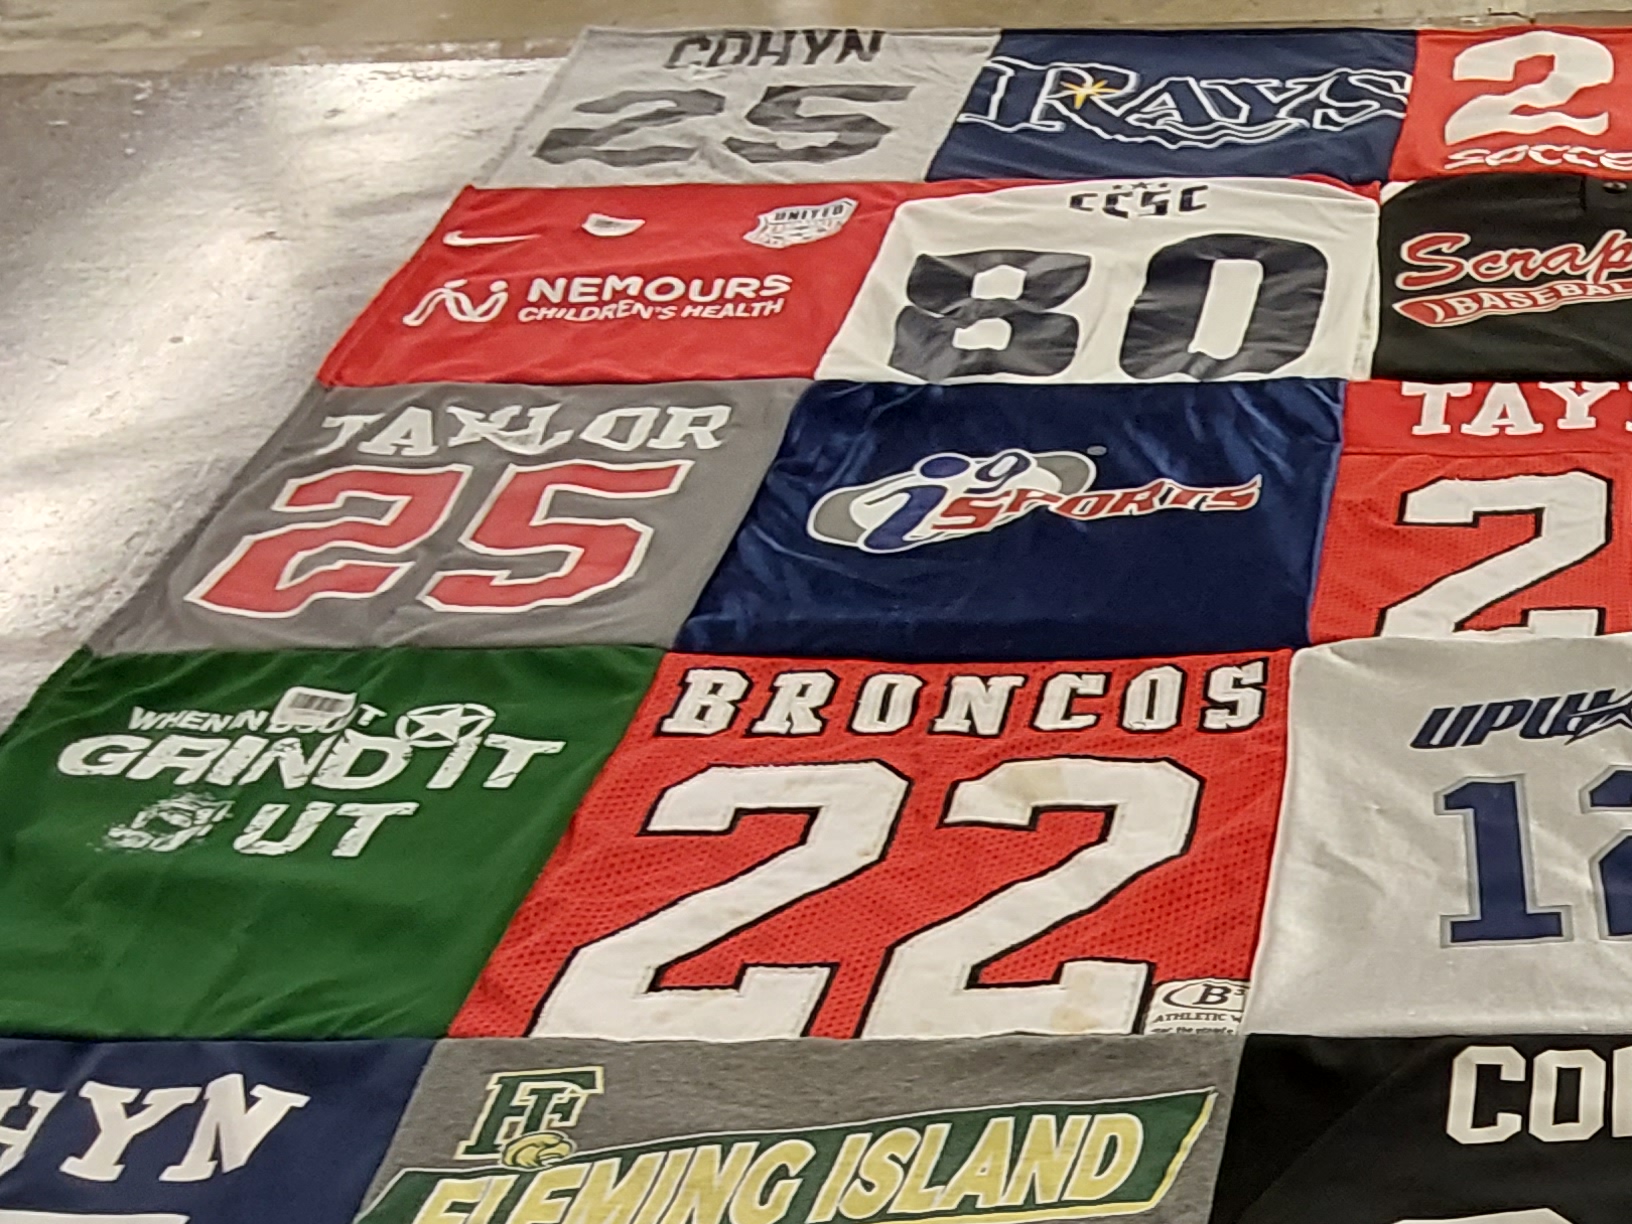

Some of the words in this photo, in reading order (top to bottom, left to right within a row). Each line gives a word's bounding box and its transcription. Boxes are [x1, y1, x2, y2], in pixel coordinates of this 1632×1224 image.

[665, 29, 886, 69] COHYN
[533, 84, 917, 168] 25
[957, 55, 1412, 149] RAYS
[1069, 184, 1208, 219] CCSC
[518, 299, 677, 322] CHILDREN'S
[681, 298, 785, 319] HEALTH
[527, 274, 793, 304] NEMOURS
[888, 232, 1328, 382] 80
[316, 403, 732, 456] TAYLOR
[184, 458, 695, 618] 25
[128, 706, 234, 733] WHEN
[654, 657, 1269, 739] BRONCOS
[57, 730, 412, 790] GRIND
[525, 755, 1206, 1038] 22
[807, 1113, 1145, 1223] ISLAND
